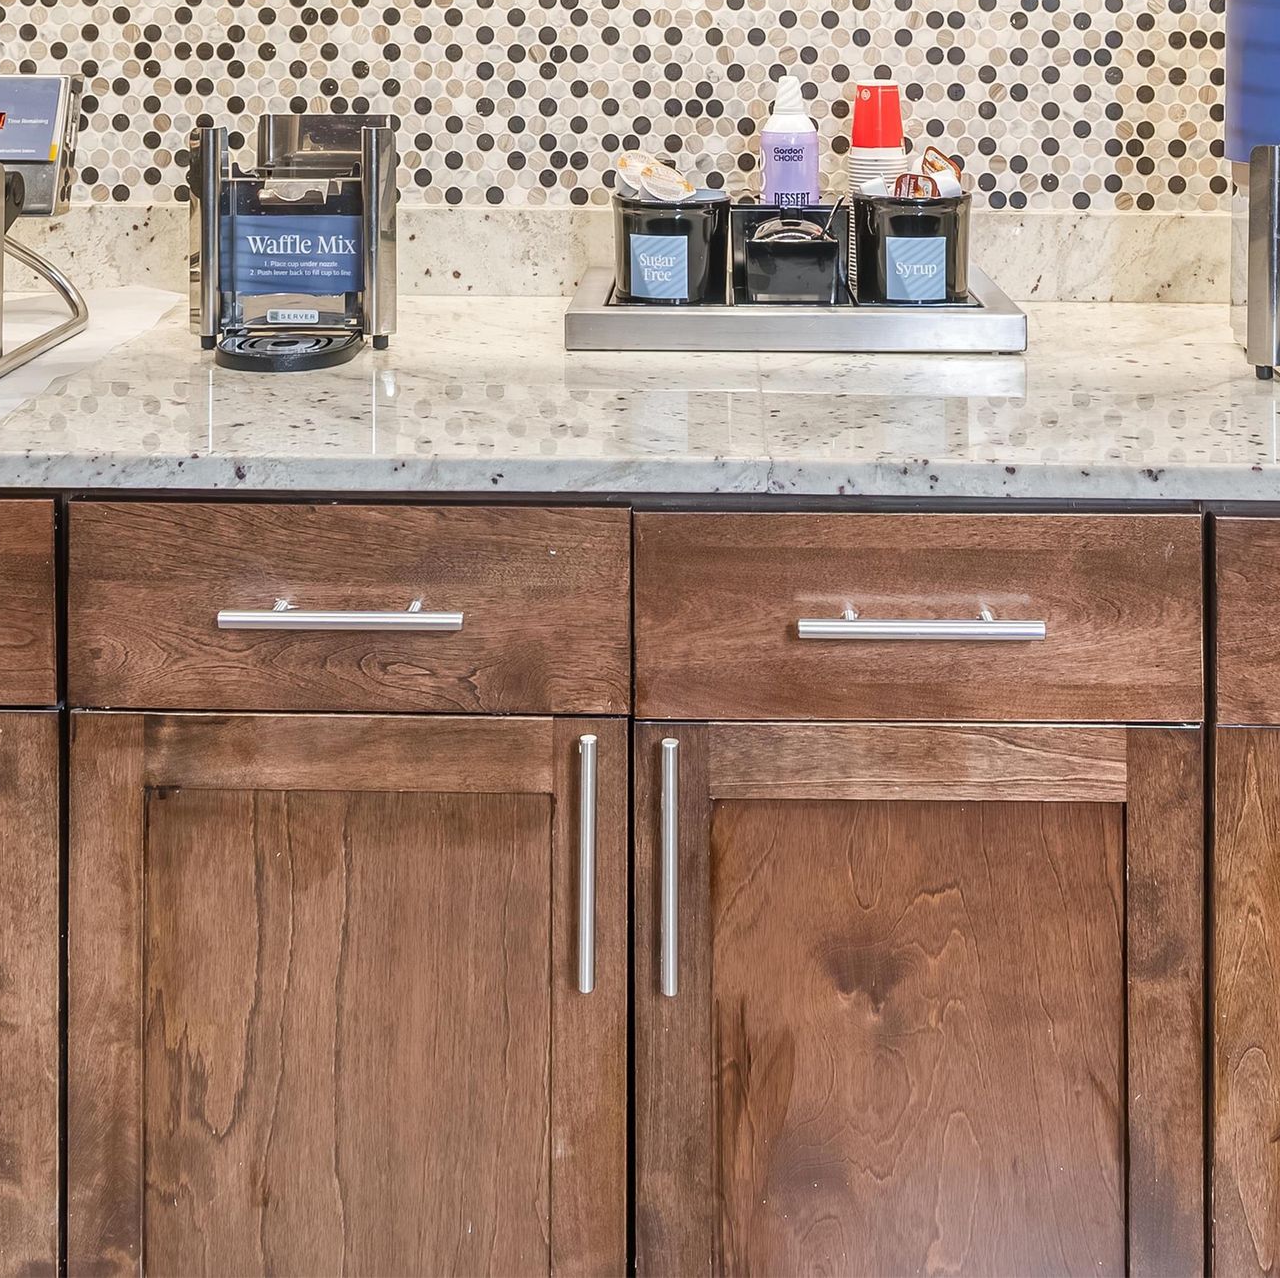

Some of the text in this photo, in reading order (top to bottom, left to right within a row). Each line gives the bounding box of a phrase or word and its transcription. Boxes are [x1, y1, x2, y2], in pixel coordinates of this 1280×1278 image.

[246, 235, 357, 254] Waffle Mix
[639, 253, 676, 269] Sugar
[643, 269, 671, 282] Free
[895, 261, 937, 278] Syrup
